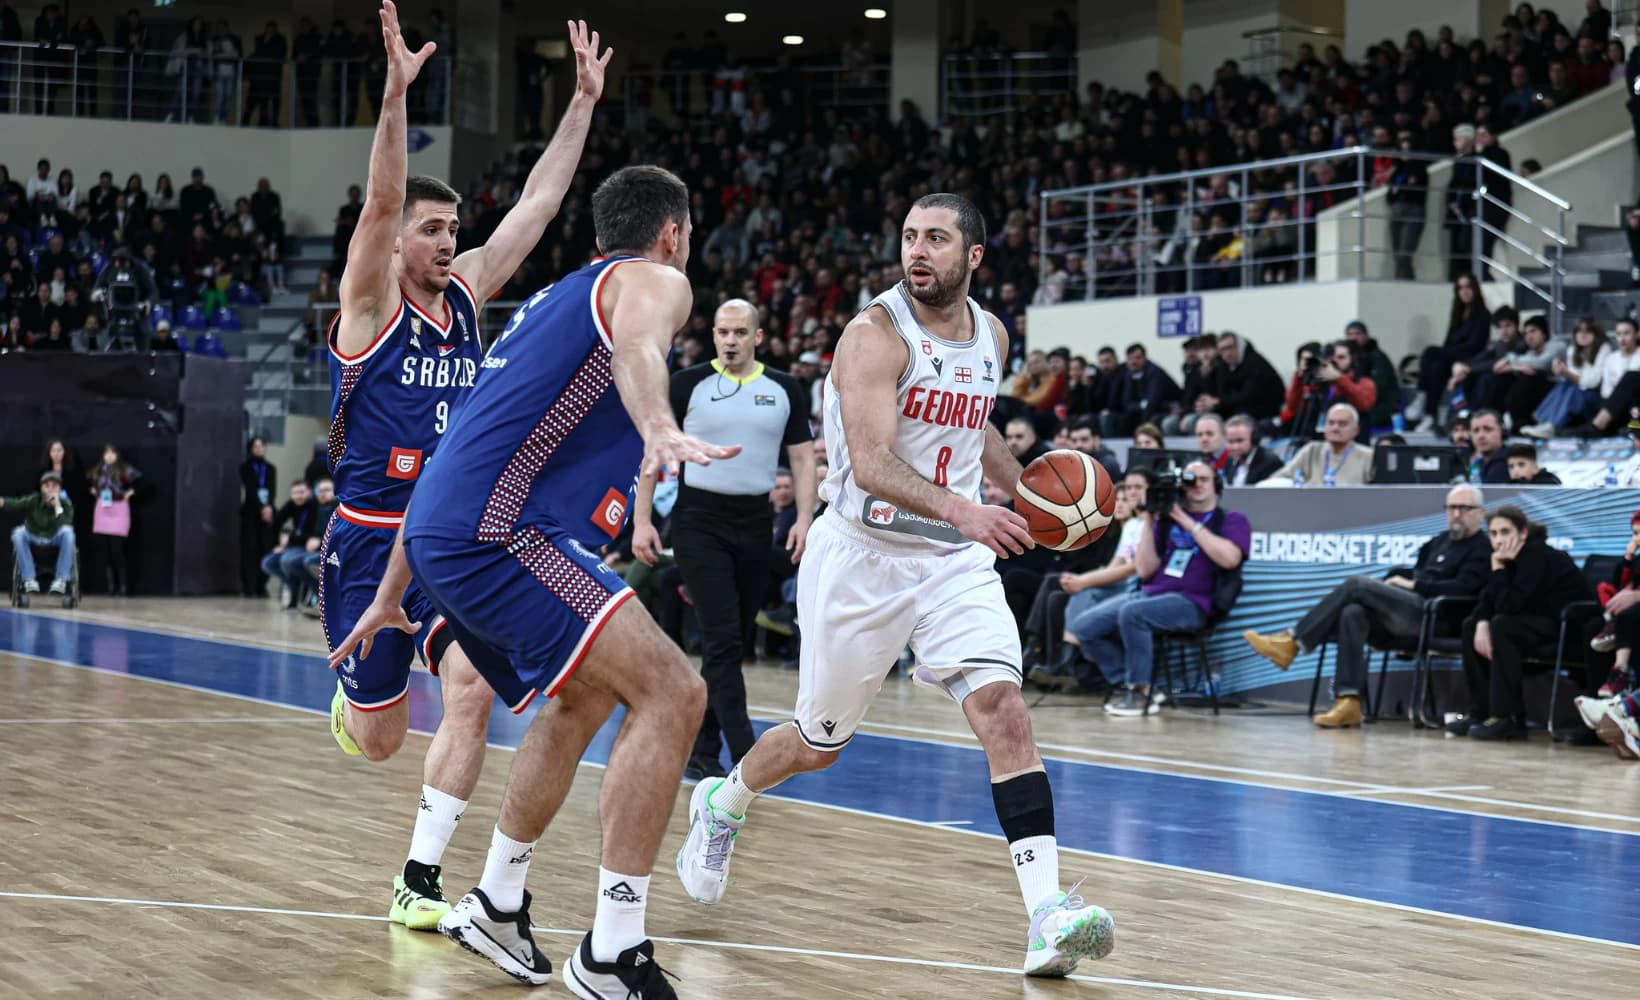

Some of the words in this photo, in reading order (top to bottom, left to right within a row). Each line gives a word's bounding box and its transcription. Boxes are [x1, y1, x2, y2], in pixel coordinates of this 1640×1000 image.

[434, 401, 449, 434] 9
[934, 446, 953, 488] 8
[1250, 531, 1375, 563] EUROBASKET
[1014, 849, 1035, 866] 23
[603, 889, 642, 903] PEAK
